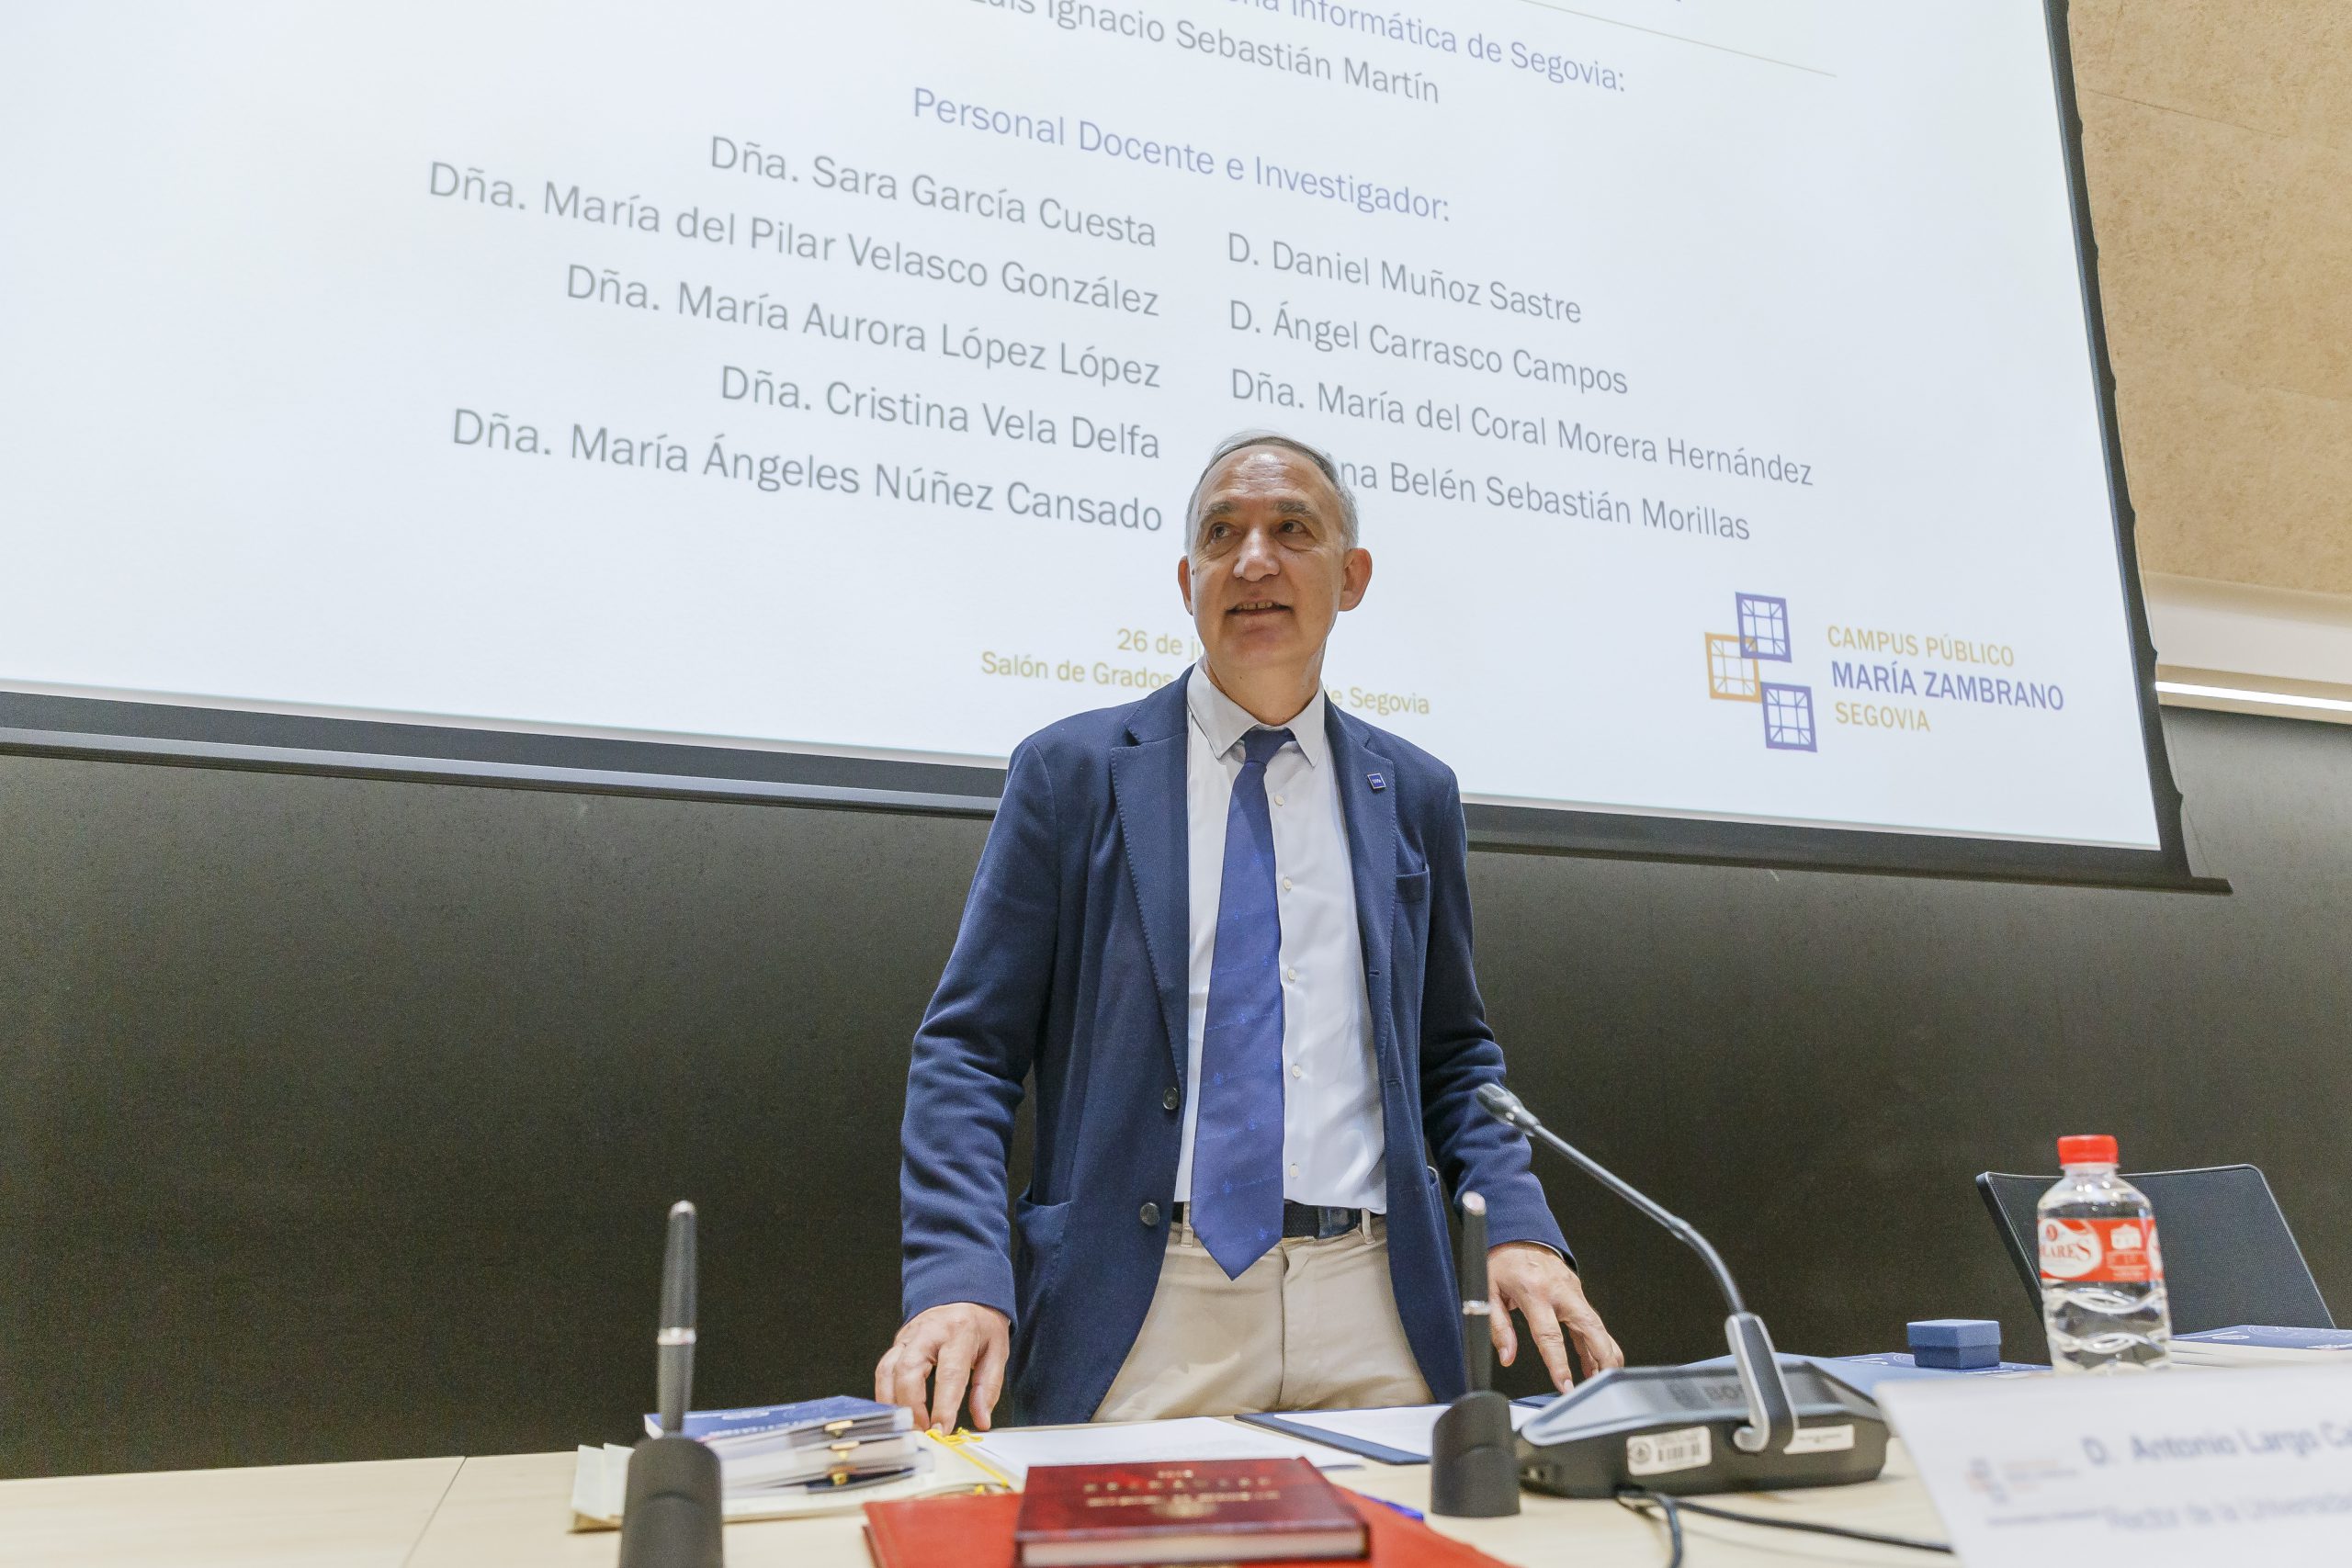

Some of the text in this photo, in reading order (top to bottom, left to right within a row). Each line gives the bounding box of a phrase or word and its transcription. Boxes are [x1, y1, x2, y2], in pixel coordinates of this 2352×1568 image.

[1048, 0, 1438, 104] Ignacio Sebastián Martín
[1467, 33, 1502, 62] de
[1511, 41, 1624, 92] Segovia:
[712, 135, 1156, 247] Dña. Sara García Cuesta
[914, 87, 1449, 221] Personal Docente e Investigador:
[430, 161, 1159, 316] Dña. María del Pilar Velasco González
[1228, 231, 1581, 323] D. Daniel Muñoz Sastre
[568, 264, 1160, 388] Dña. María Aurora López López
[1230, 299, 1628, 394] D. Ángel Carrasco Campos
[722, 365, 1159, 458] Dña. Cristina Vela Delfa
[1232, 367, 1813, 486] Dña. María del Coral Morera Hernández
[453, 408, 1162, 532] Dña. María Ángeles Núñez Cansado
[1391, 462, 1476, 502] Belén
[1487, 476, 1631, 525] Sebastián
[1642, 498, 1749, 540] Morillas
[981, 650, 1048, 679] Salón
[1056, 660, 1085, 683] de
[1349, 686, 1430, 716] Segovia
[1117, 627, 1148, 652] 26
[1155, 633, 1182, 655] de
[1827, 625, 2014, 667] CAMPUS PÚBLICO
[1831, 660, 2064, 711] MARÍA ZAMBRANO
[1835, 701, 1930, 732] SEGOVIA
